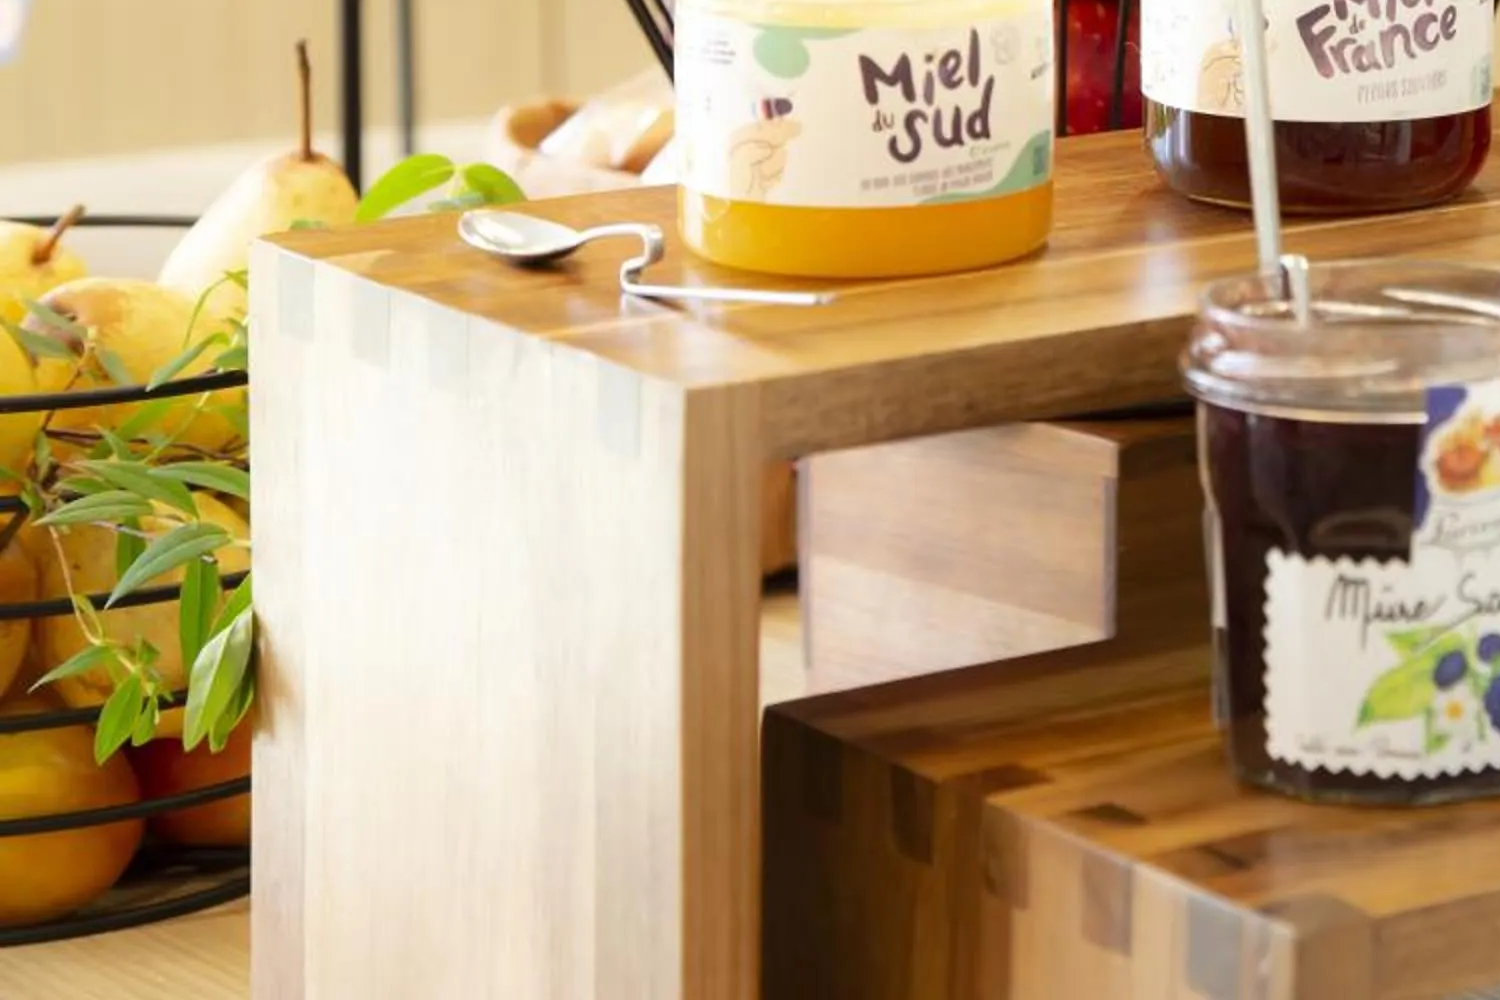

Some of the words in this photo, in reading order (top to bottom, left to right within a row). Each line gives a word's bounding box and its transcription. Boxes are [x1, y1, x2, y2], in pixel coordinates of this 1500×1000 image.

[1296, 4, 1457, 79] France
[1350, 14, 1366, 35] de
[858, 27, 980, 106] Miel
[872, 110, 895, 132] du
[888, 76, 995, 163] Sud
